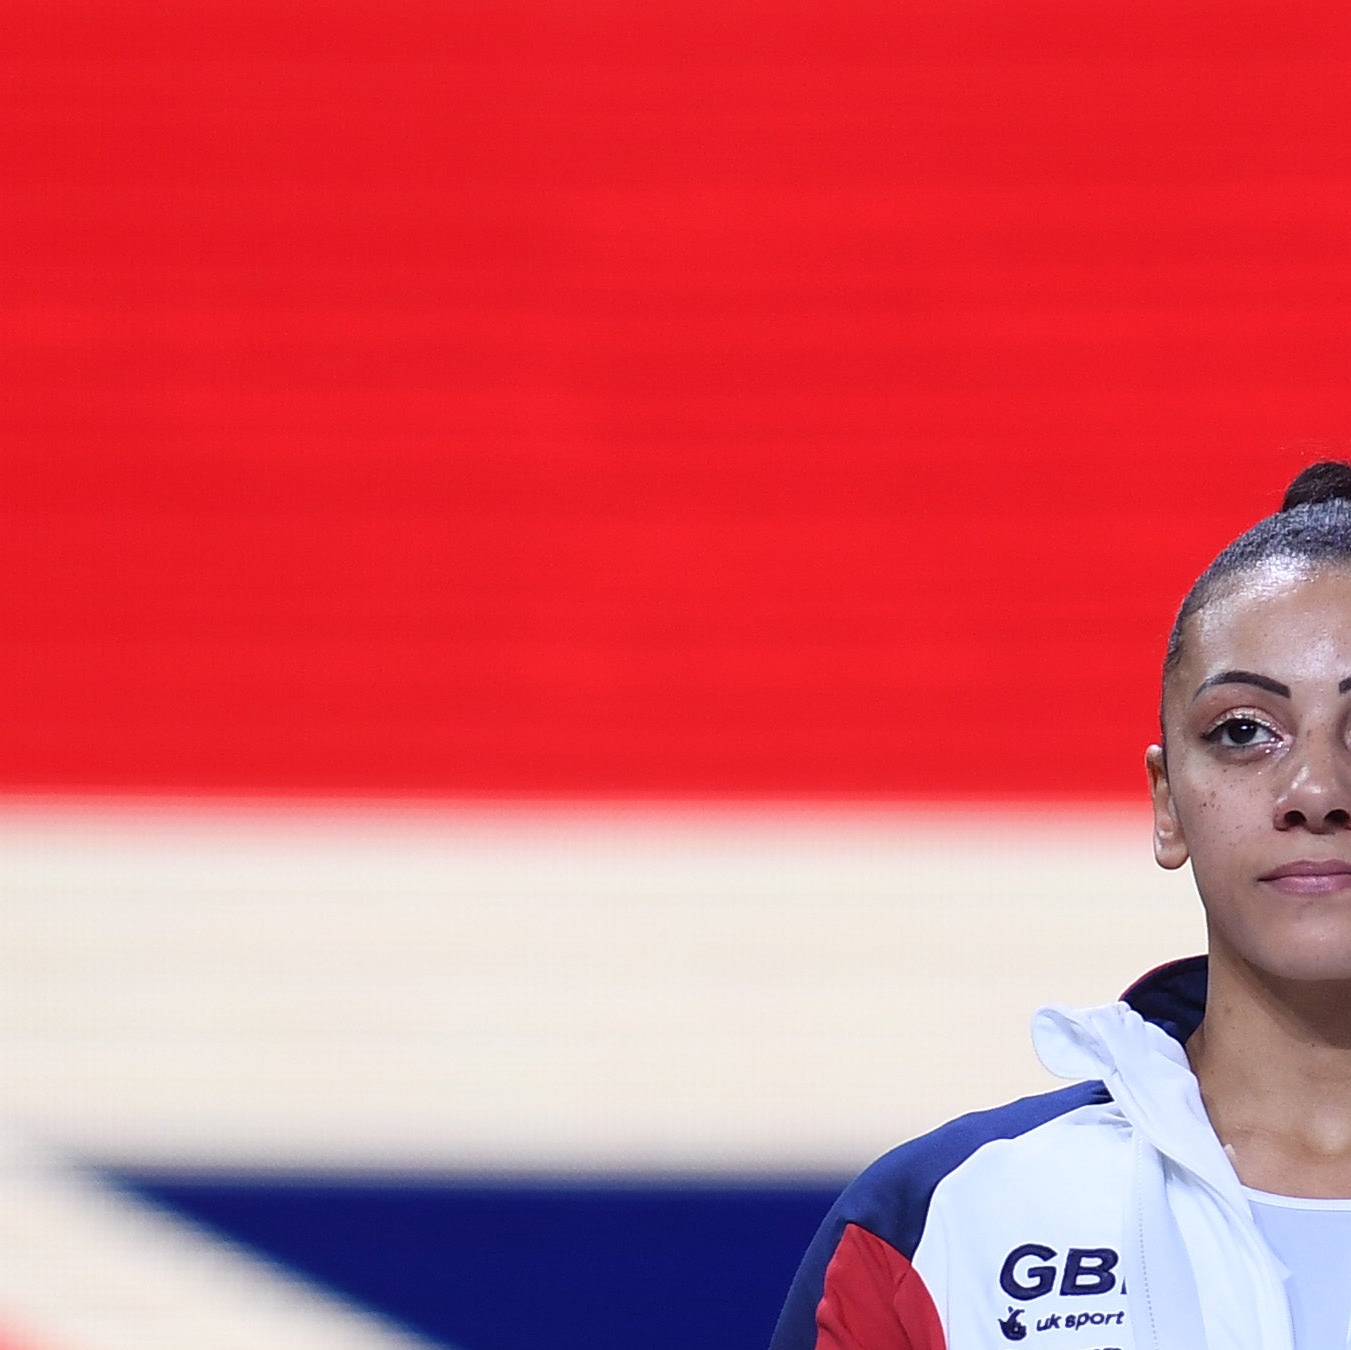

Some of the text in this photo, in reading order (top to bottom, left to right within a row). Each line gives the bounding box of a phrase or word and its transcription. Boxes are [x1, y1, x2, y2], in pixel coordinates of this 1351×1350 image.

[999, 1243, 1127, 1301] GB
[1036, 1311, 1125, 1331] uk sport
